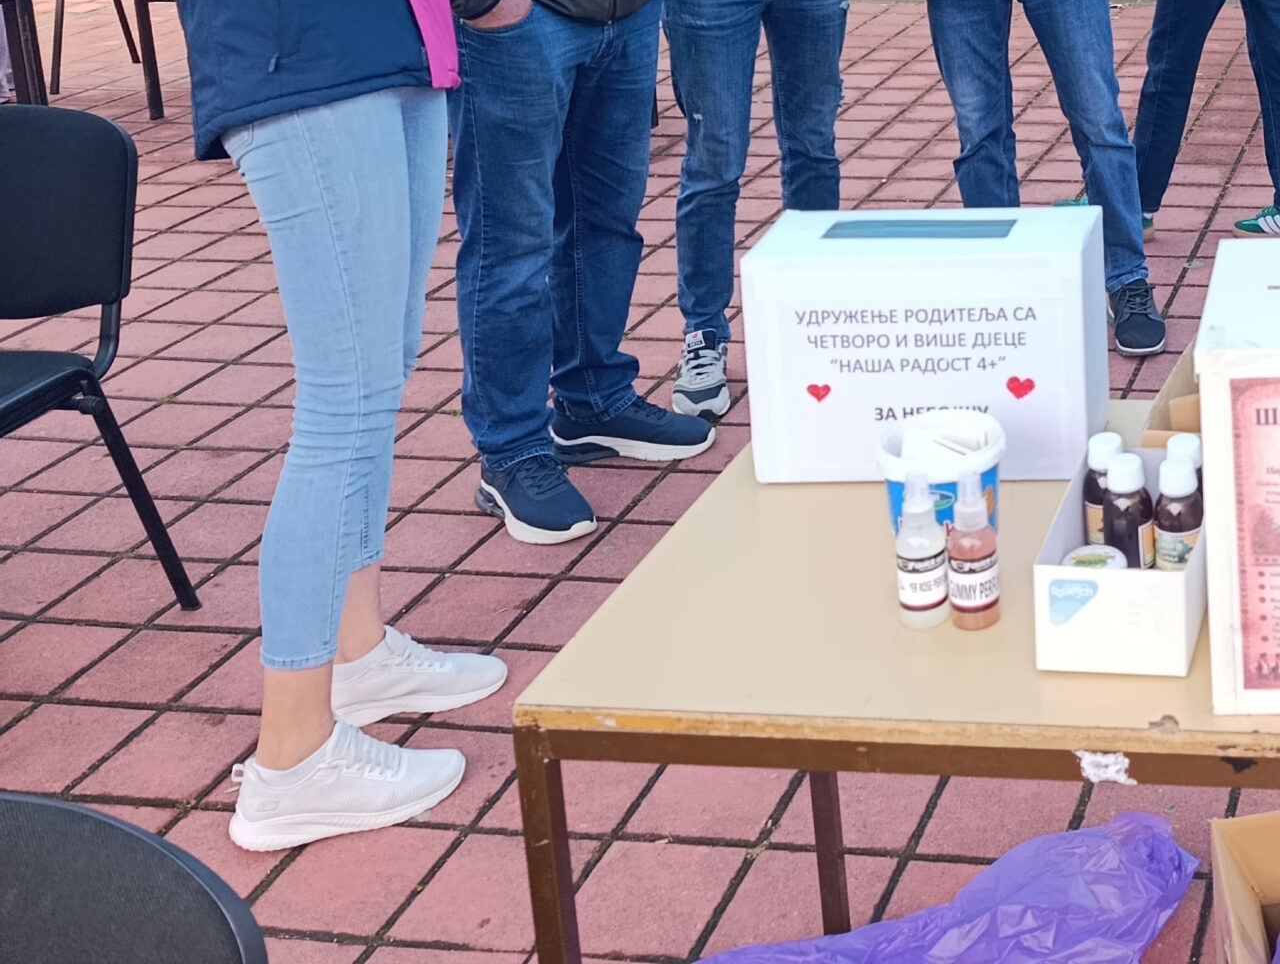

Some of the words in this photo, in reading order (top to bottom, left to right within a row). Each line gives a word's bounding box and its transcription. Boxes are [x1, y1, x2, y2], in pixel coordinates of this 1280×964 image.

[794, 309, 899, 327] УДРУЖЕЊЕ
[904, 307, 1009, 325] РОДИТЕЉА
[1013, 306, 1037, 322] СА
[807, 334, 890, 349] ЧЕТВОРО
[896, 333, 908, 348] И
[914, 332, 967, 348] ВИШЕ
[972, 331, 1027, 349] ДЈЕЦЕ
[900, 357, 972, 375] РАДОСТ
[874, 407, 898, 422] ЗА
